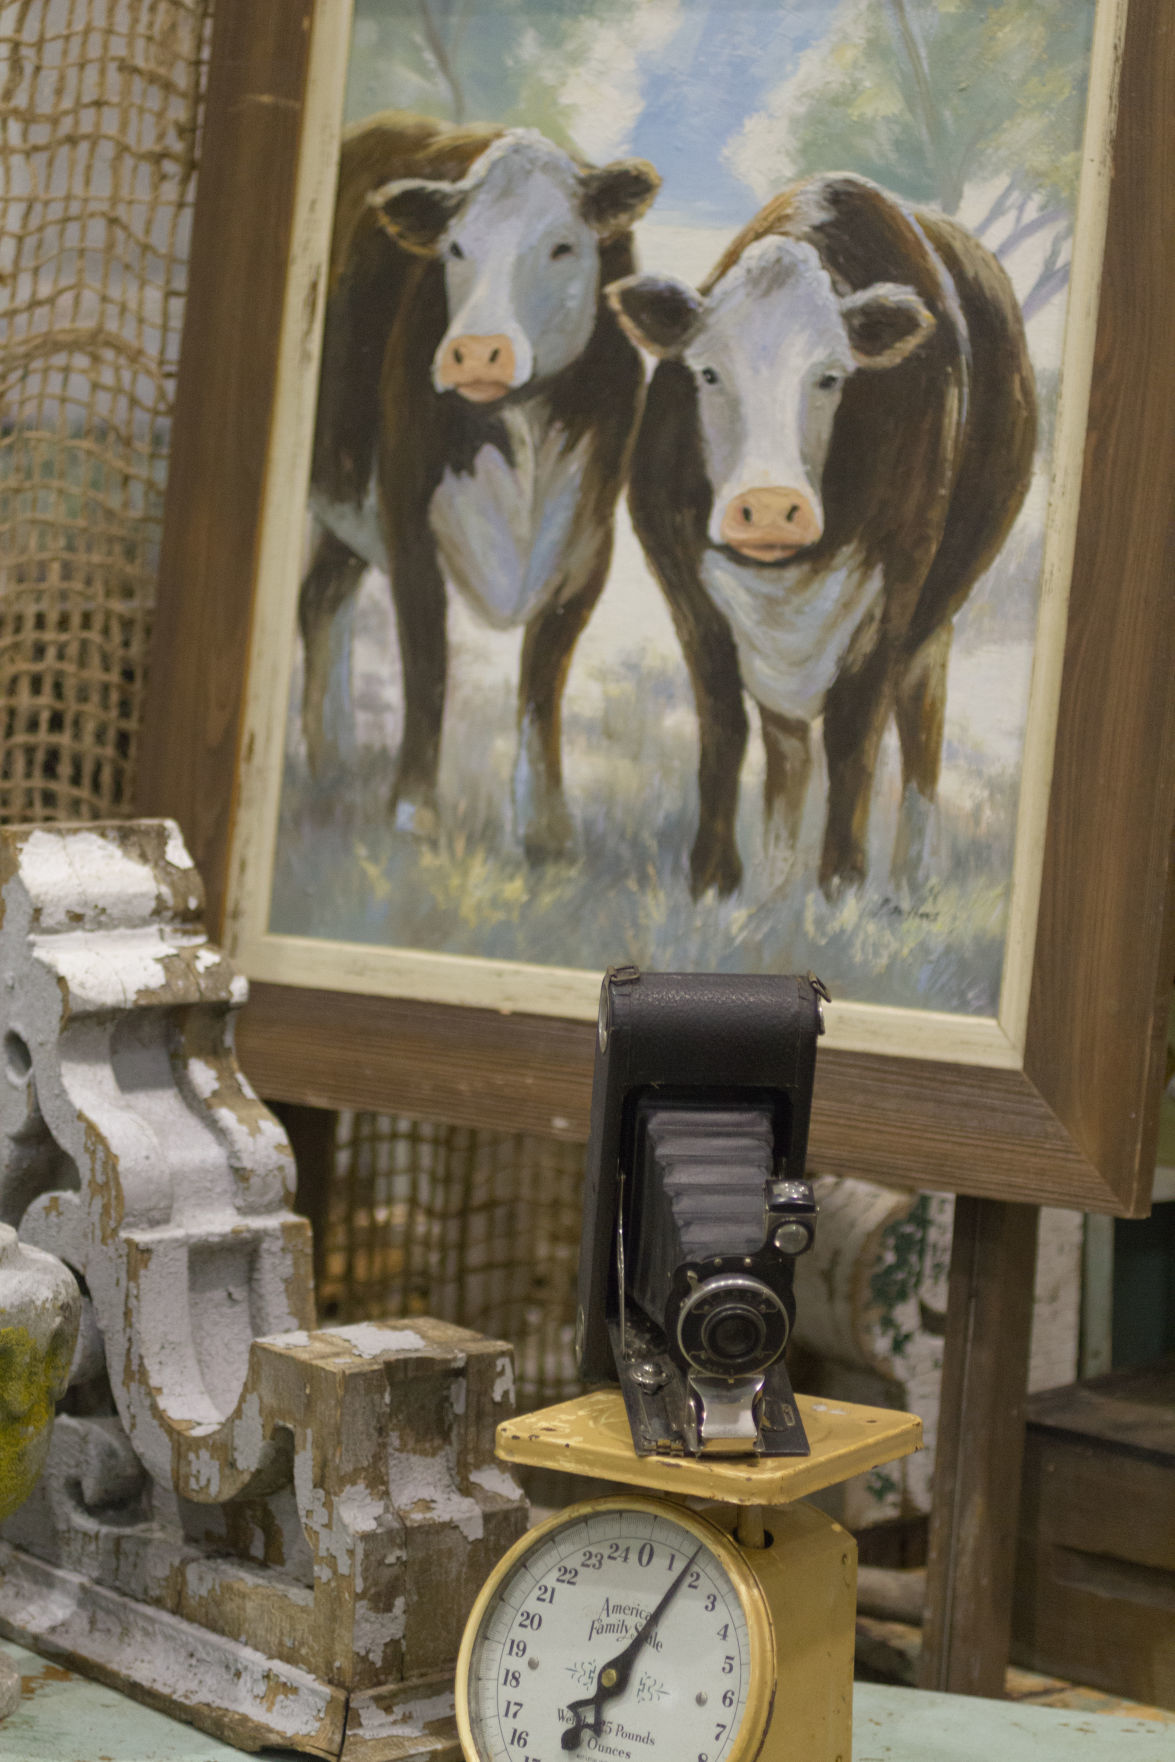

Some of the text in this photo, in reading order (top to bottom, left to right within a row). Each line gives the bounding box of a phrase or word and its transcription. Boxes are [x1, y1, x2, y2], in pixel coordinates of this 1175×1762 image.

[580, 1550, 604, 1570] 23
[606, 1543, 631, 1563] 24
[637, 1542, 655, 1568] 0
[667, 1553, 676, 1572] 1
[555, 1565, 579, 1586] 22
[687, 1571, 701, 1590] 2
[536, 1585, 556, 1605] 21
[704, 1593, 718, 1613] 3
[518, 1610, 543, 1632] 20
[599, 1597, 657, 1626] America
[588, 1619, 630, 1641] Family
[716, 1624, 730, 1641] 4
[507, 1639, 528, 1658] 19
[721, 1655, 735, 1674] 5
[502, 1668, 522, 1689] 18
[721, 1689, 735, 1708] 6
[503, 1700, 524, 1720] 17
[509, 1727, 529, 1749] 16
[616, 1723, 655, 1746] Pounds
[714, 1723, 727, 1742] 7
[587, 1737, 632, 1760] Ounces
